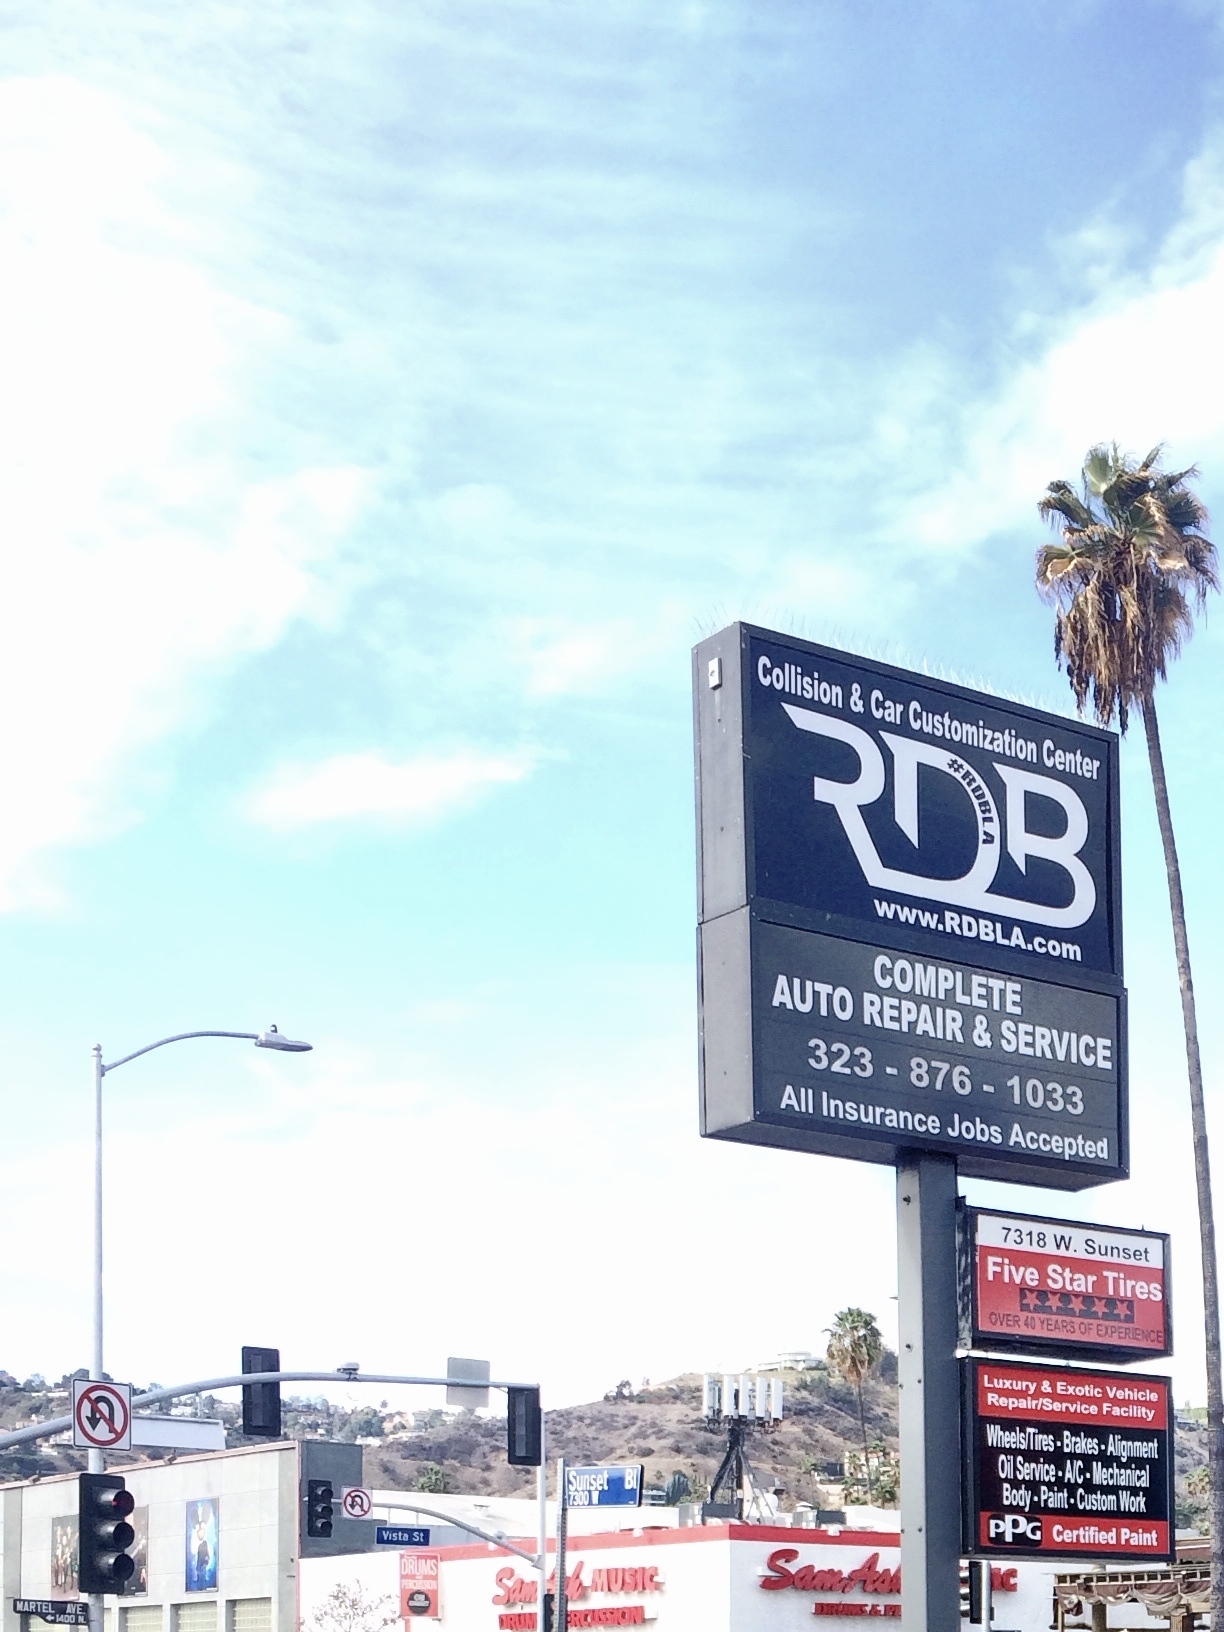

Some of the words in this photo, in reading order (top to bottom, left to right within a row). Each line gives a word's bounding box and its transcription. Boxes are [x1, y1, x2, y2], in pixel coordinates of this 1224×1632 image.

[757, 655, 843, 709] Collision
[849, 682, 865, 714] &
[870, 689, 904, 725] Car
[908, 700, 1038, 763] Customization
[1042, 739, 1101, 780] Center
[780, 702, 1097, 930] RDB
[946, 758, 995, 845] #RDBLA
[873, 898, 1082, 962] www.RDBLA.com
[873, 954, 1022, 1016] COMPLETE
[771, 974, 854, 1021] AUTO
[863, 991, 965, 1044] REPAIR
[972, 1014, 993, 1049] &
[1001, 1019, 1113, 1070] SERVICE
[807, 1037, 875, 1078] 323
[909, 1056, 973, 1096] 876
[1006, 1074, 1085, 1115] 1033
[780, 1084, 814, 1114] All
[822, 1091, 941, 1135] Insurance
[947, 1112, 1003, 1145] Jobs
[1009, 1122, 1109, 1161] Accepted
[1001, 1226, 1047, 1249] 7318
[1053, 1233, 1078, 1253] W.
[1084, 1238, 1150, 1263] Sunset
[986, 1255, 1040, 1288] Five
[1046, 1263, 1097, 1294] Star
[1102, 1270, 1163, 1302] Tires
[988, 1311, 1021, 1329] OVER
[1024, 1314, 1036, 1330] 40
[1038, 1318, 1076, 1335] YEARS
[1079, 1321, 1094, 1336] OF
[1096, 1323, 1165, 1344] EXPERIENCE
[983, 1374, 1037, 1395] Luxury
[1040, 1380, 1053, 1393] &
[1056, 1381, 1103, 1399] Exotic
[1106, 1385, 1159, 1402] Vehicle
[987, 1392, 1099, 1415] Repair/Service
[1102, 1402, 1156, 1422] Facility
[986, 1423, 1055, 1452] Wheels/Tires
[1063, 1430, 1099, 1456] Brakes
[1107, 1434, 1159, 1462] Alignment
[568, 1470, 608, 1491] Sunset
[624, 1468, 637, 1490] Bl
[998, 1454, 1014, 1480] Oil
[1016, 1456, 1056, 1483] Service
[1064, 1459, 1084, 1484] A/C
[1092, 1461, 1150, 1488] Mechanical
[568, 1491, 589, 1506] 7300
[592, 1491, 600, 1505] W
[1002, 1483, 1032, 1512] Body
[1040, 1485, 1069, 1510] Paint
[1076, 1488, 1118, 1513] Custom
[1118, 1490, 1147, 1513] Work
[382, 1530, 409, 1542] Vista
[412, 1531, 424, 1542] St
[989, 1514, 1042, 1542] PPG
[1052, 1524, 1117, 1545] Certified
[1120, 1527, 1158, 1547] Paint
[401, 1558, 438, 1576] DRUMS
[590, 1566, 659, 1593] MUSIC
[16, 1600, 55, 1613] MARTEL
[66, 1603, 86, 1615] AVE.
[55, 1614, 76, 1623] 1400
[499, 1612, 538, 1631] DRUM
